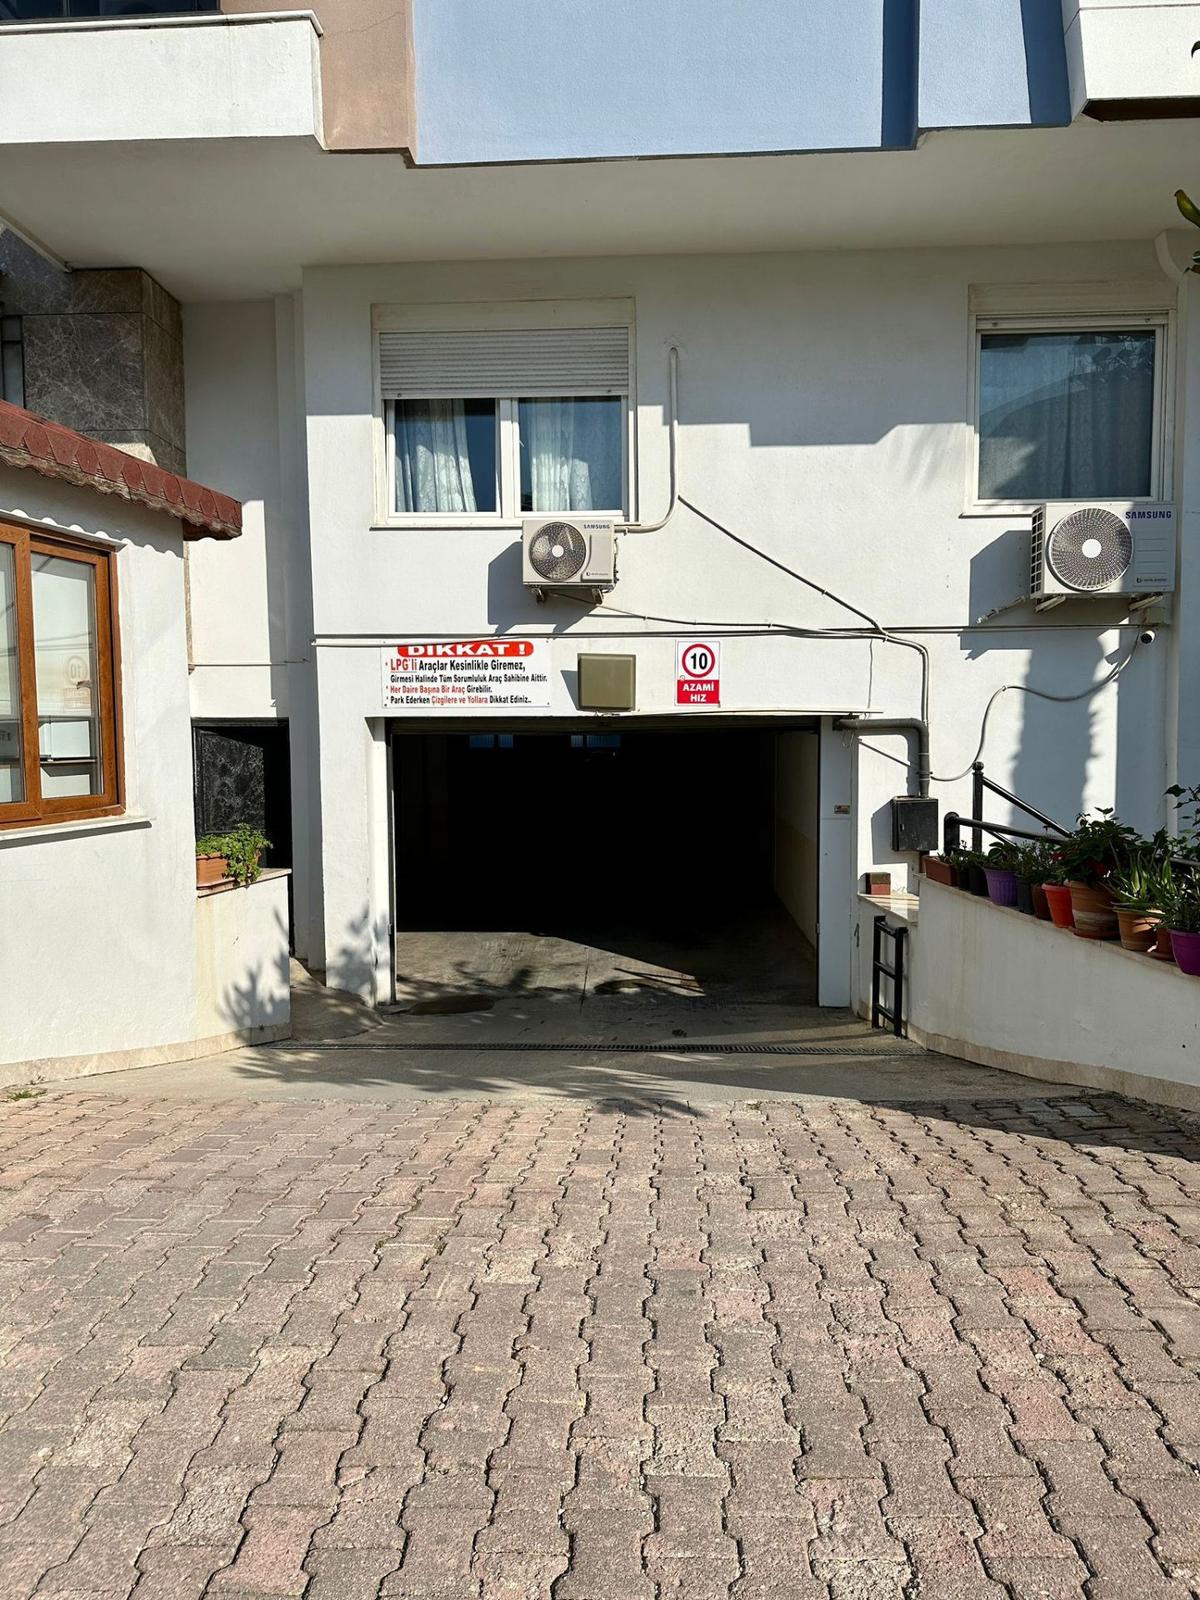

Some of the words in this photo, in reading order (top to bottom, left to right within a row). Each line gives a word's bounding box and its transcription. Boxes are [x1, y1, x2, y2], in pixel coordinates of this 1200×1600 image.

[1125, 511, 1172, 519] SAMSUNG
[419, 660, 448, 673] Araçlar
[450, 660, 489, 671] Kesinlikle
[491, 659, 526, 672] Giremez,
[691, 652, 708, 670] 10
[390, 674, 414, 683] Girmesi
[415, 674, 438, 683] Halinde
[439, 674, 452, 683] Tüm
[453, 674, 487, 683] Sorumluluk
[488, 674, 503, 684] Araç
[503, 673, 530, 683] Sahibine
[531, 673, 548, 682] Aittir.
[390, 685, 401, 694] Her
[402, 685, 418, 694] Daire
[420, 685, 440, 695] Başına
[441, 685, 450, 694] Bir
[451, 685, 465, 695] Araç
[466, 685, 492, 693] Girebilir.
[682, 681, 715, 692] AZAMİ
[390, 696, 405, 704] Park
[406, 696, 430, 704] Ederken
[431, 695, 458, 706] Çizgilere
[467, 695, 488, 704] Yollara
[490, 695, 509, 704] Dikkat
[690, 693, 707, 703] HIZ
